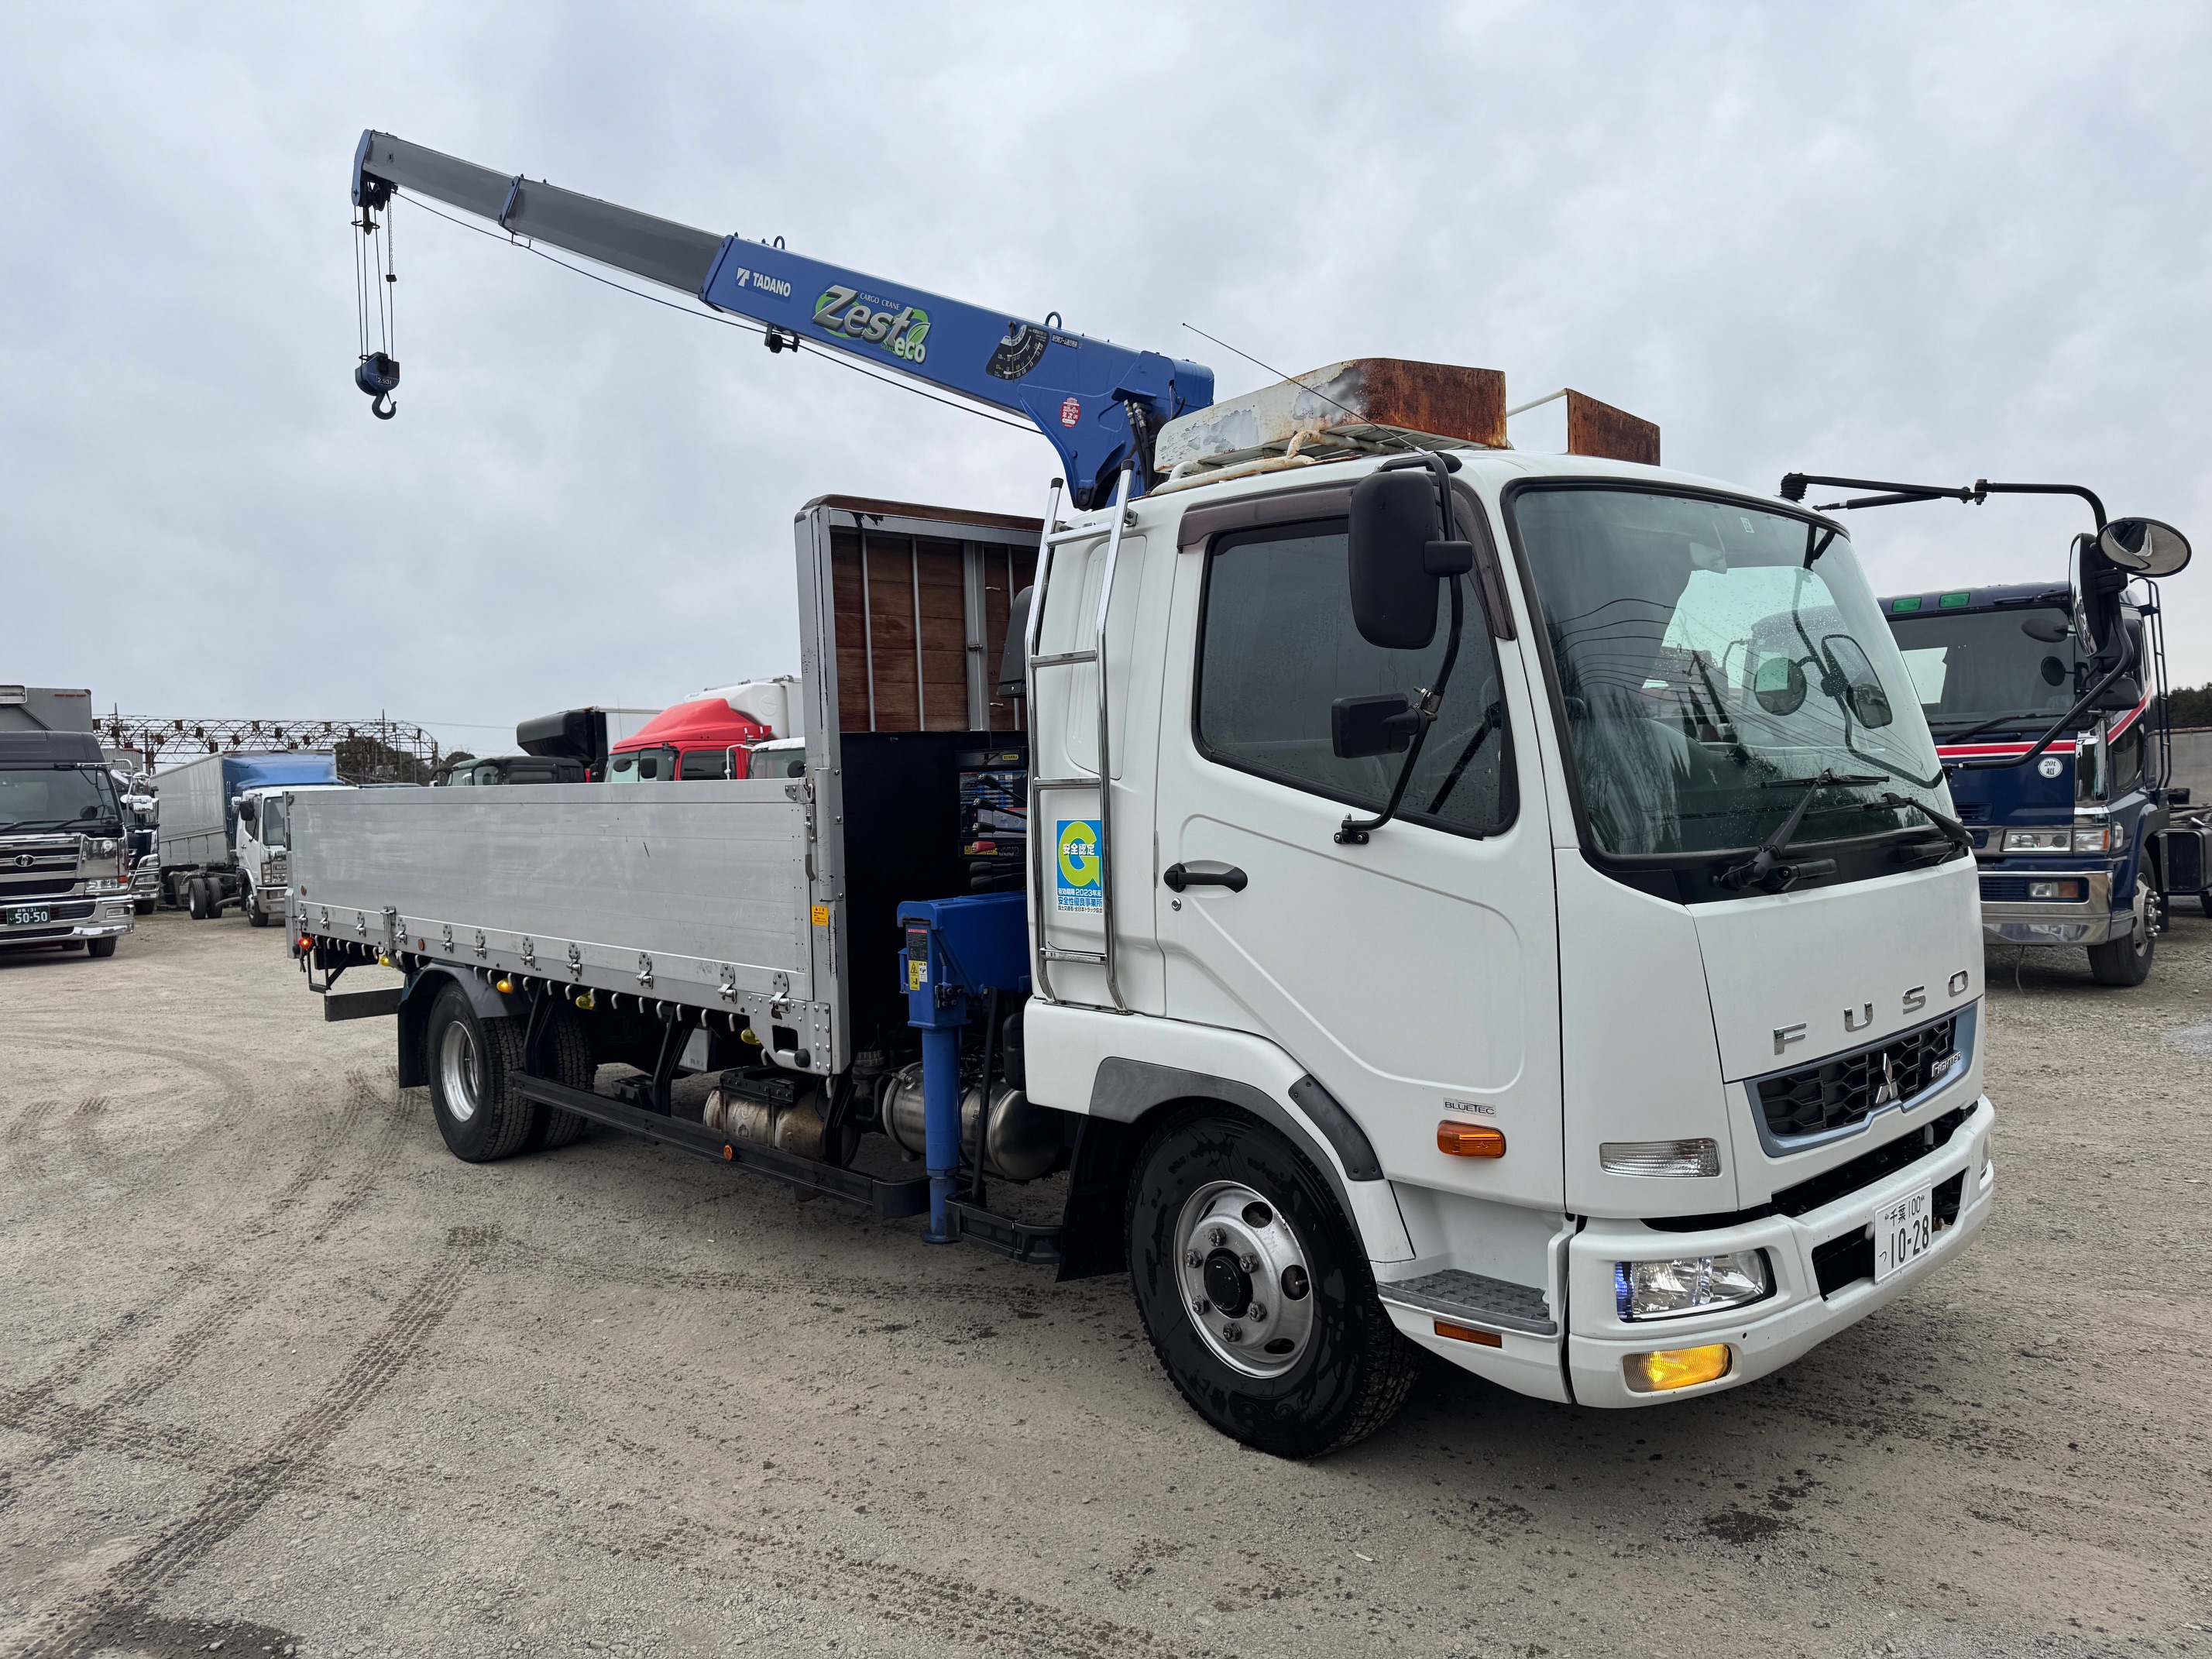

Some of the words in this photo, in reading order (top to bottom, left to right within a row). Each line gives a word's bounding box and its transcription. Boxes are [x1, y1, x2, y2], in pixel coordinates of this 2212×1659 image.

[753, 273, 791, 297] TADANO
[860, 292, 879, 304] CARGO
[881, 299, 900, 311] CRANE
[812, 284, 915, 348] Zest
[894, 337, 926, 363] eco
[1063, 843, 1095, 856] 安全認定
[1058, 896, 1102, 908] 安全性優良事業所
[1075, 888, 1102, 897] 2023年末
[15, 912, 48, 924] 50-50
[1774, 970, 1969, 1055] FUSO
[1444, 1101, 1495, 1115] BLUETEC
[1890, 1204, 1906, 1227] 千葉
[1908, 1195, 1921, 1218] 100
[1879, 1251, 1887, 1262] つ
[1891, 1214, 1929, 1269] 10-28
